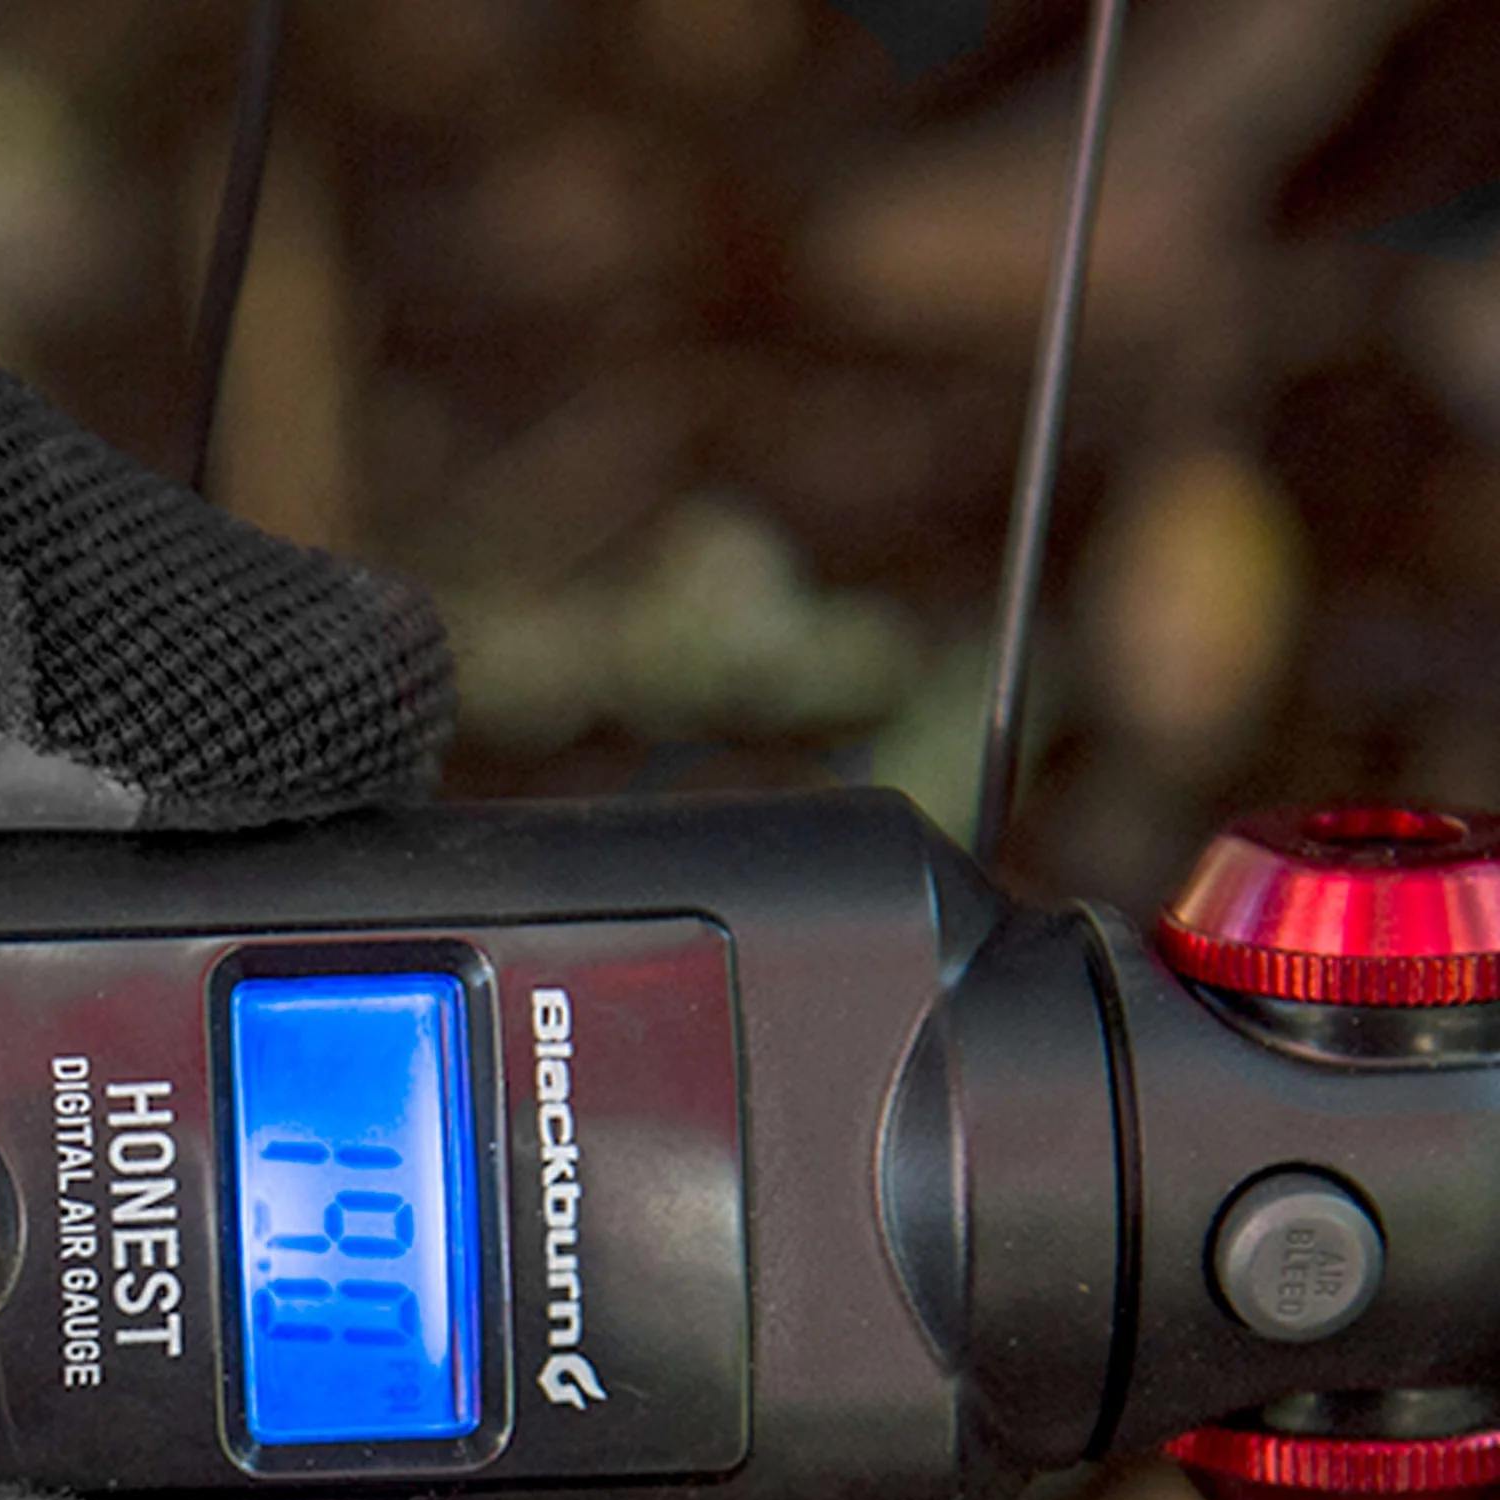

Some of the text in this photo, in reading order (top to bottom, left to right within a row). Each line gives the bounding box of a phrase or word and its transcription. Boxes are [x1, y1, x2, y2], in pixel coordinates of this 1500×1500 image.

[52, 1056, 102, 1388] DIGITAL AIR GAUGE
[105, 1080, 182, 1358] HONEST
[530, 988, 583, 1347] Blackburn
[1276, 1228, 1316, 1317] BLEED
[1315, 1249, 1347, 1299] AIR
